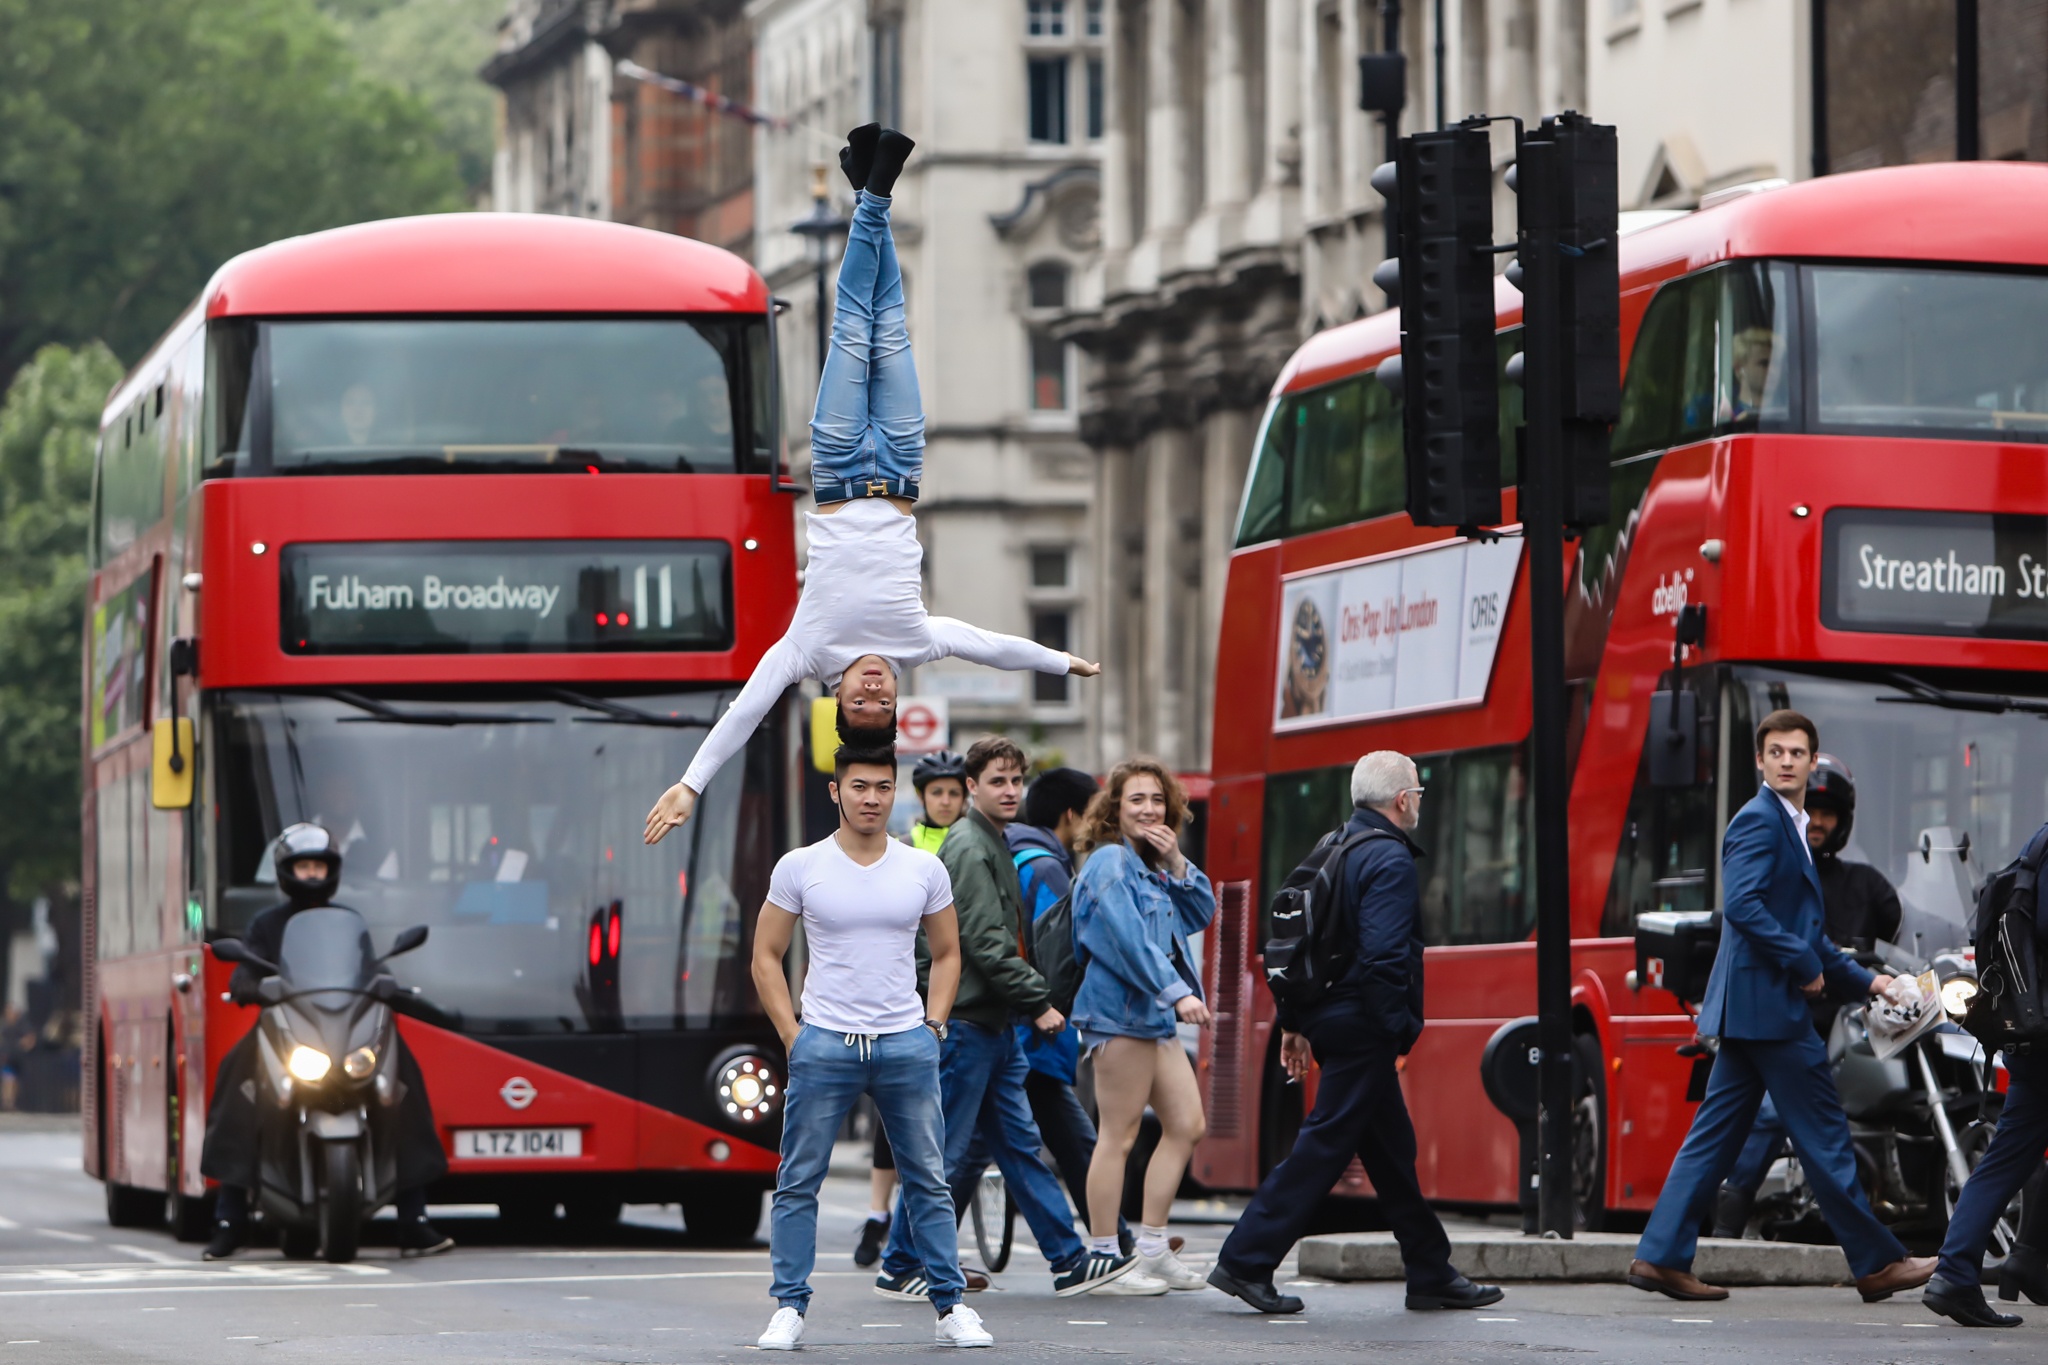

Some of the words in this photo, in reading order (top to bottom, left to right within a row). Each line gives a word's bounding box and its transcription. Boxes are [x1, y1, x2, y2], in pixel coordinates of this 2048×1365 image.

[1858, 543, 2006, 596] Streatham
[2016, 553, 2048, 599] St
[309, 575, 414, 609] Fulham
[423, 575, 560, 618] Broadway
[634, 564, 672, 629] 11
[1341, 604, 1360, 643] Oris
[1363, 600, 1382, 645] Pop
[1400, 590, 1439, 630] London
[1470, 591, 1499, 630] ORIS
[472, 1131, 516, 1154] LTZ
[522, 1131, 564, 1153] 1041
